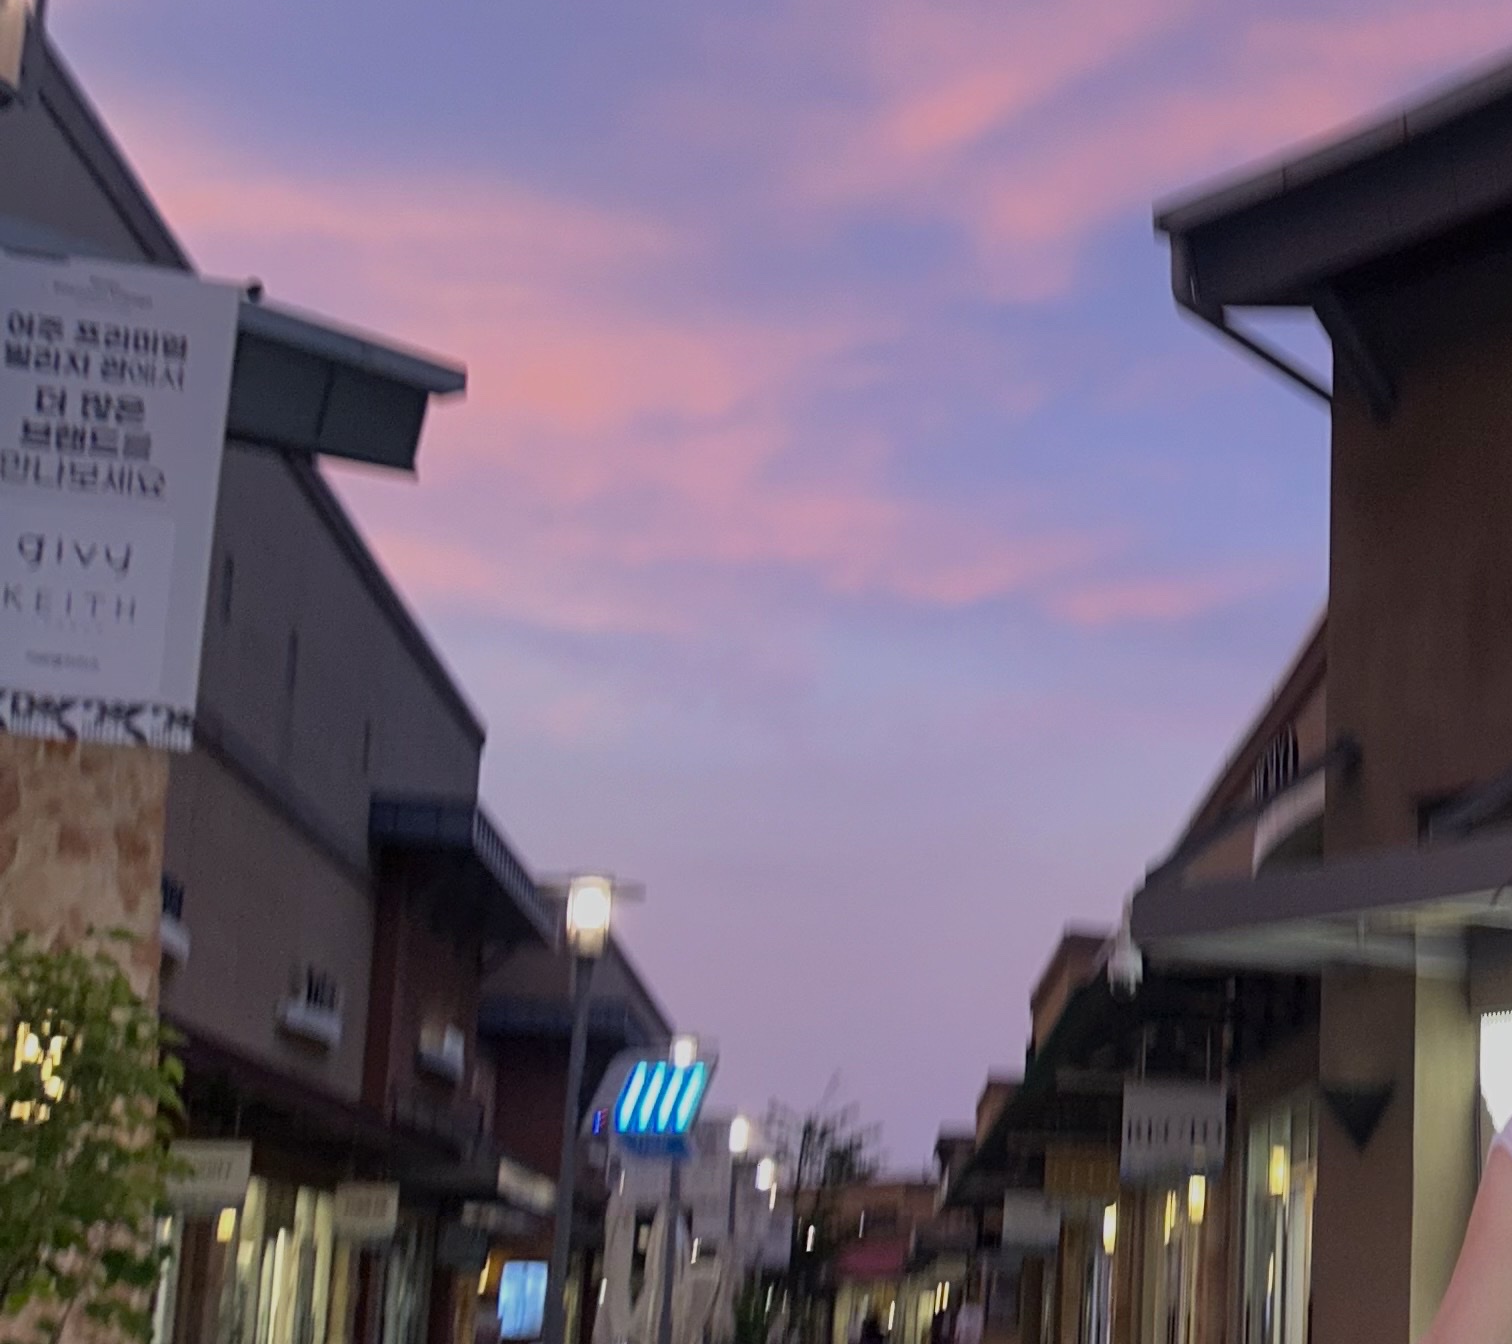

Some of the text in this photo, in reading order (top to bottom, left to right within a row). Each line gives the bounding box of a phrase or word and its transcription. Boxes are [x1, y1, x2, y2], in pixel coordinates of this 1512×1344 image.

[36, 385, 67, 417] 더
[20, 417, 151, 460] 브랜드를
[2, 581, 136, 624] KEITH
